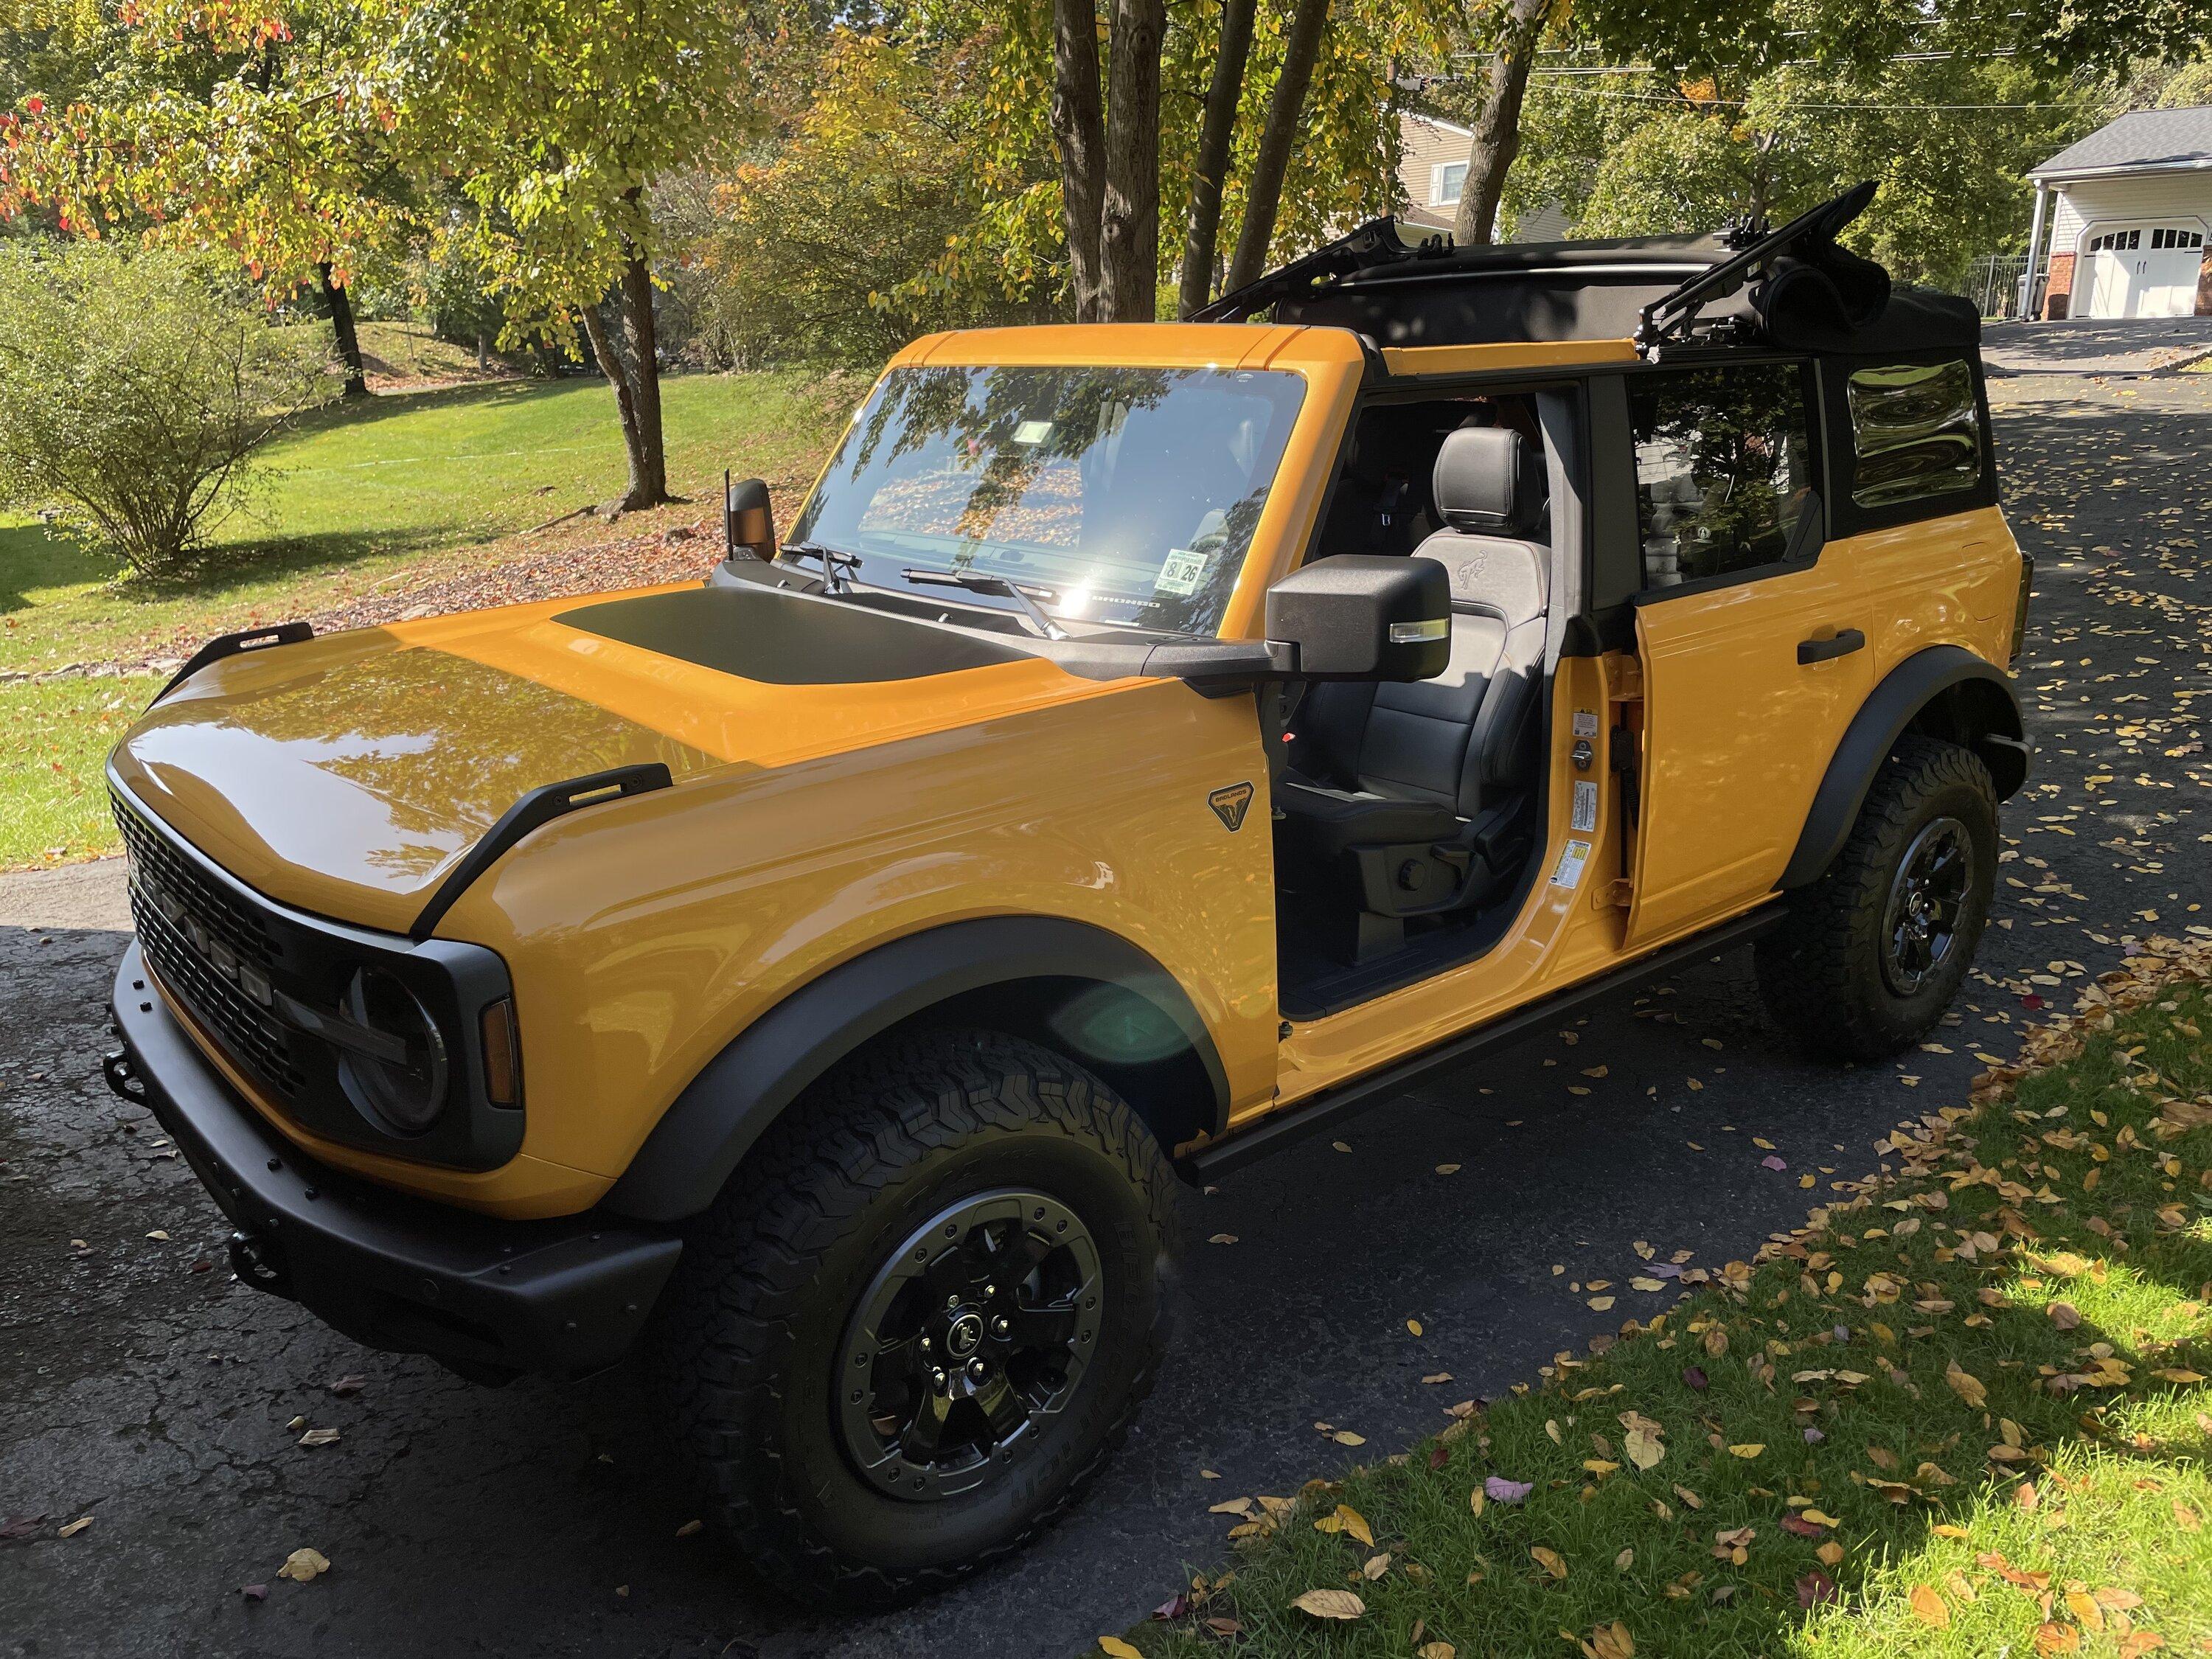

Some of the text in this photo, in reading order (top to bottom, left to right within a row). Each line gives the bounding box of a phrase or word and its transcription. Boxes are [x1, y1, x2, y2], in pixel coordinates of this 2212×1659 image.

[1166, 562, 1178, 577] 8
[1180, 565, 1198, 582] 26
[1092, 596, 1161, 608] BRONCO
[1215, 790, 1247, 802] BADLANDS
